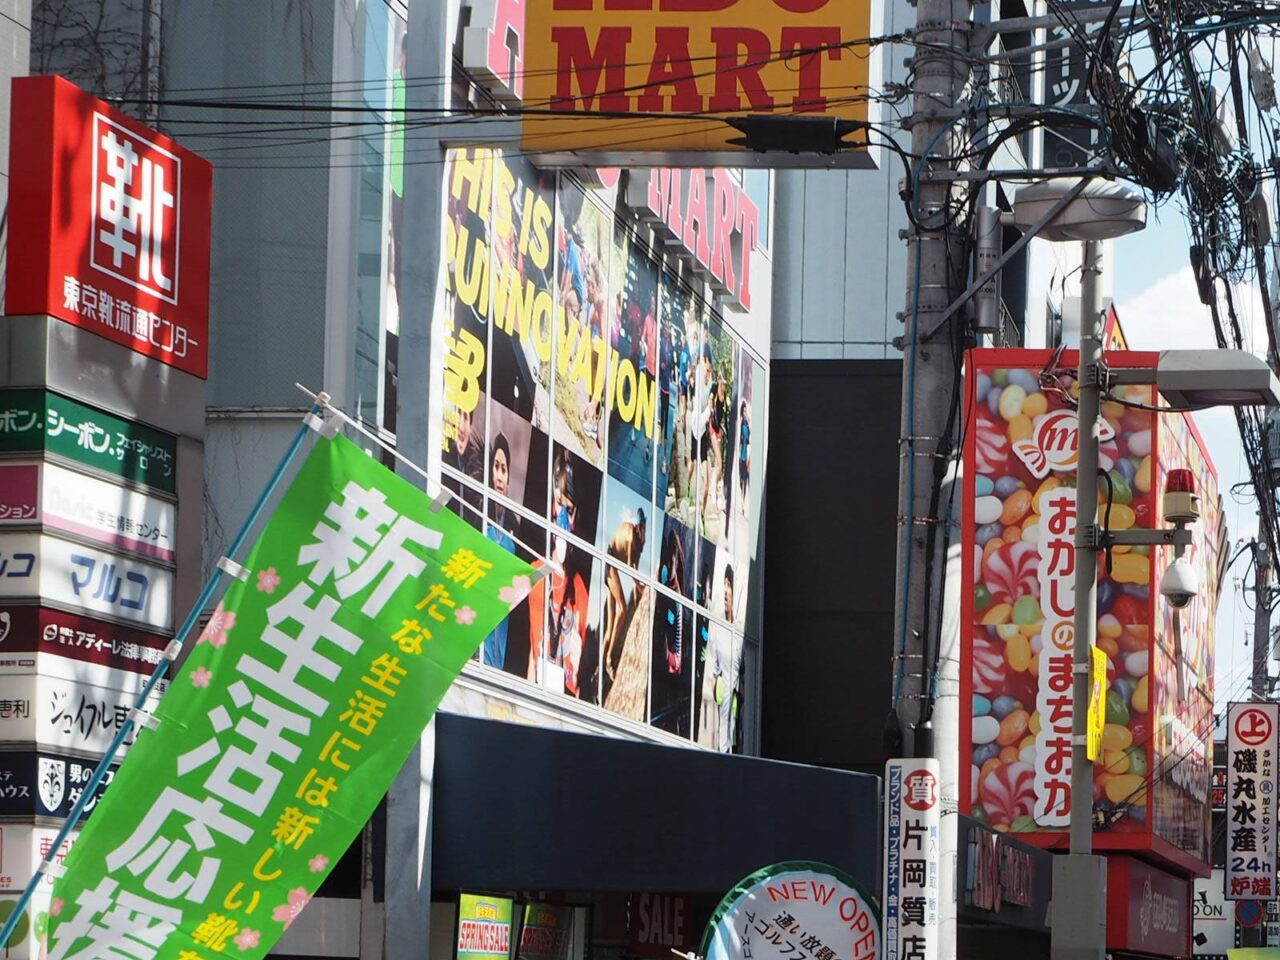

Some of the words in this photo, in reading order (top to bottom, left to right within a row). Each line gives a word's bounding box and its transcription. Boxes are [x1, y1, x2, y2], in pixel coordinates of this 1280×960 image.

[550, 27, 841, 112] MART
[100, 130, 174, 291] 靴
[62, 275, 199, 358] 東京靴流通センター
[70, 553, 149, 611] マルコ
[910, 774, 935, 804] 質
[1232, 747, 1258, 852] 磯丸水産
[1231, 857, 1271, 873] 24h
[1231, 876, 1272, 897] 炉端
[766, 880, 837, 906] NEW
[638, 895, 685, 947] SALE
